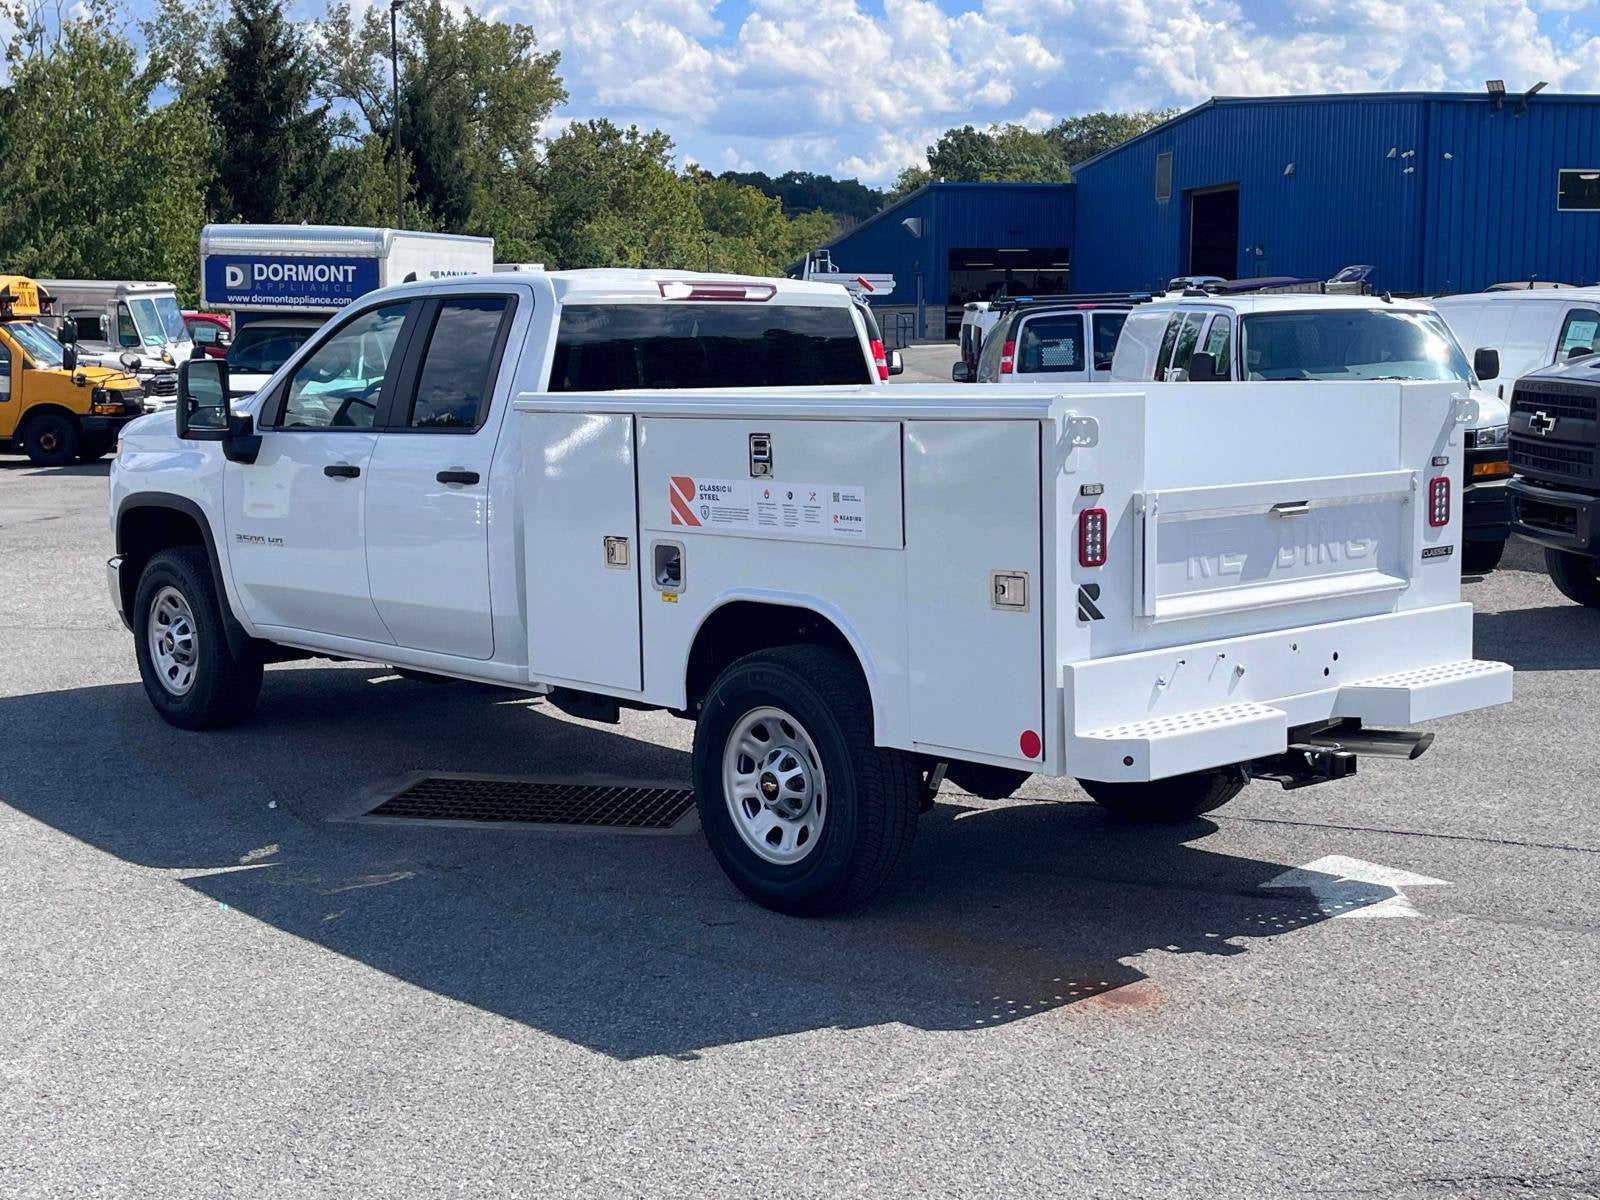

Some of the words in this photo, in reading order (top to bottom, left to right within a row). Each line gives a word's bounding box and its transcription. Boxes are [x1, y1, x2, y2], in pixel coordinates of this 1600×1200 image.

[253, 263, 357, 282] DORMONT
[255, 283, 353, 293] APPLIANCE
[227, 294, 352, 305] wwwdormontappliance.com
[700, 484, 727, 493] CLASSIC
[700, 493, 720, 501] STEEL
